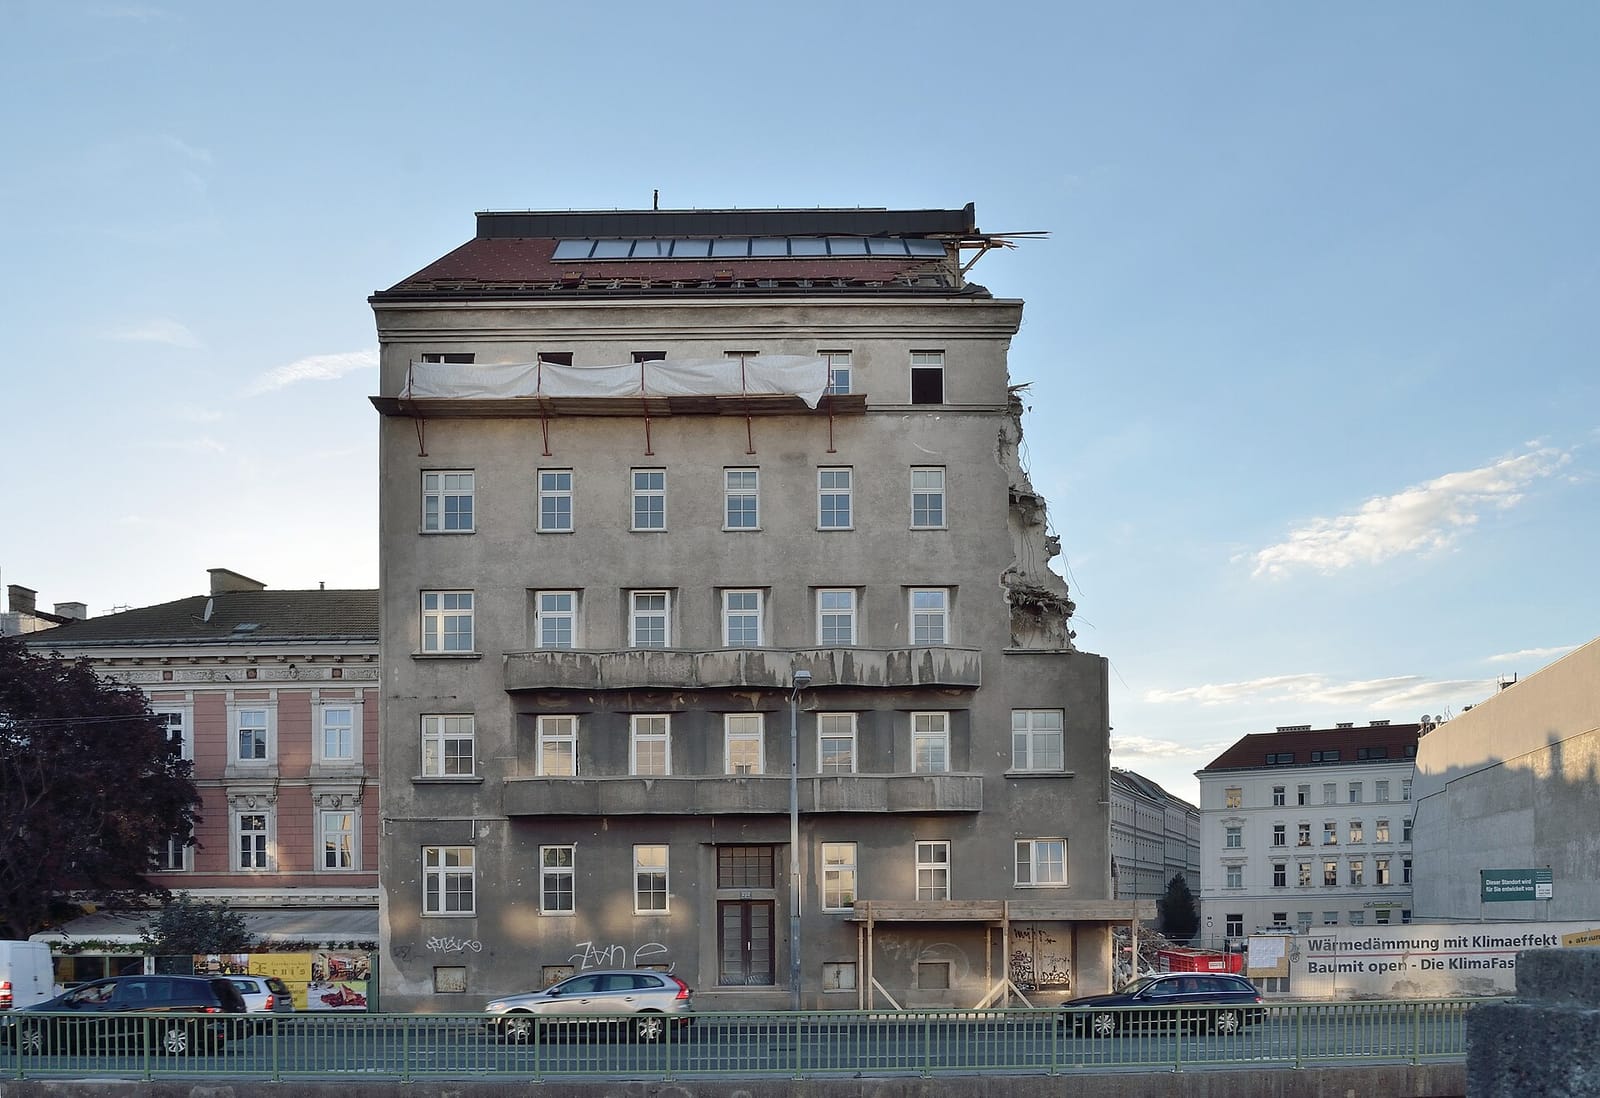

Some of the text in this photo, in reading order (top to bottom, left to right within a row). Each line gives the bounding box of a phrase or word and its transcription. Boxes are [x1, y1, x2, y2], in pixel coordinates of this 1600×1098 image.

[1308, 934, 1557, 951] Wärmedämmung mit Klimaeffekt
[1308, 960, 1364, 973] Baumit
[1368, 962, 1407, 974] open
[1421, 958, 1444, 970] Die
